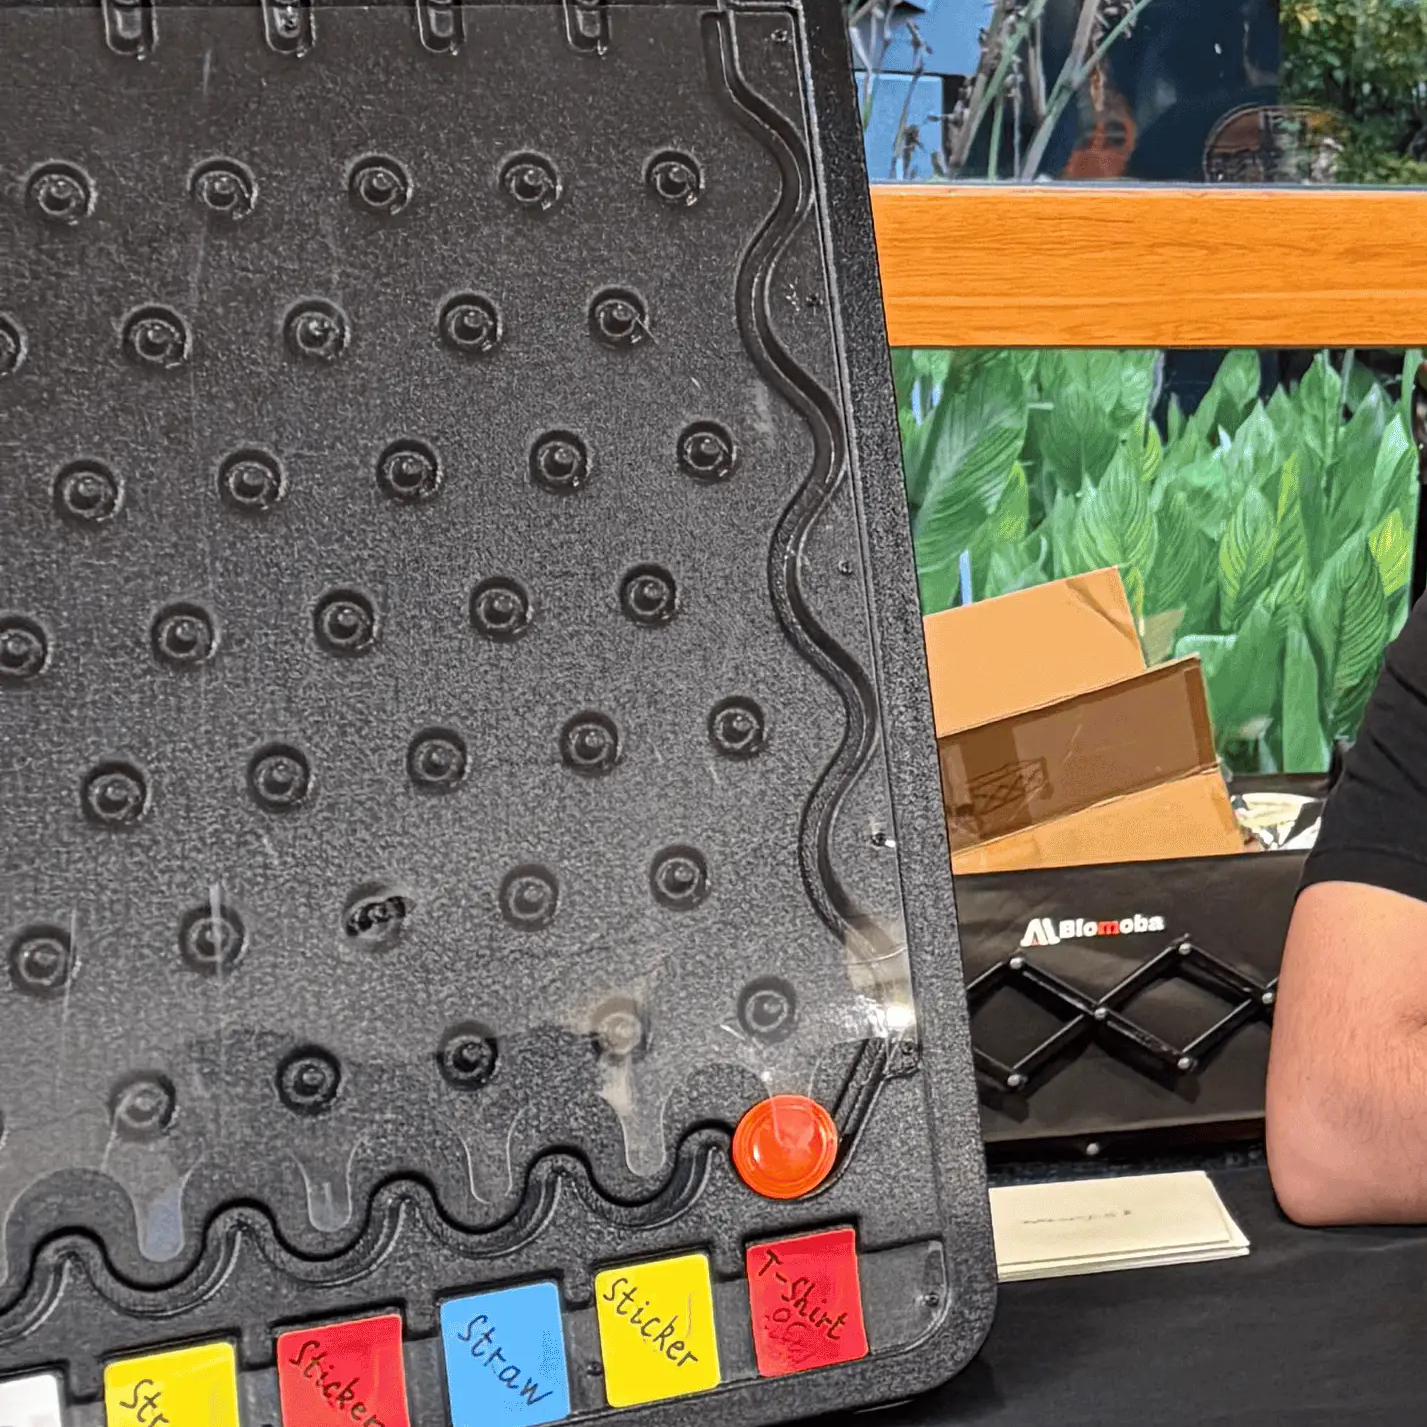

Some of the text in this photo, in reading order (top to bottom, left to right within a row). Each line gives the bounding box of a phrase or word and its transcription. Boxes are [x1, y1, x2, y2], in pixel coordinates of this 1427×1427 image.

[603, 1277, 699, 1369] Sticker
[758, 1249, 848, 1340] T-Shirt
[458, 1314, 554, 1407] Straw
